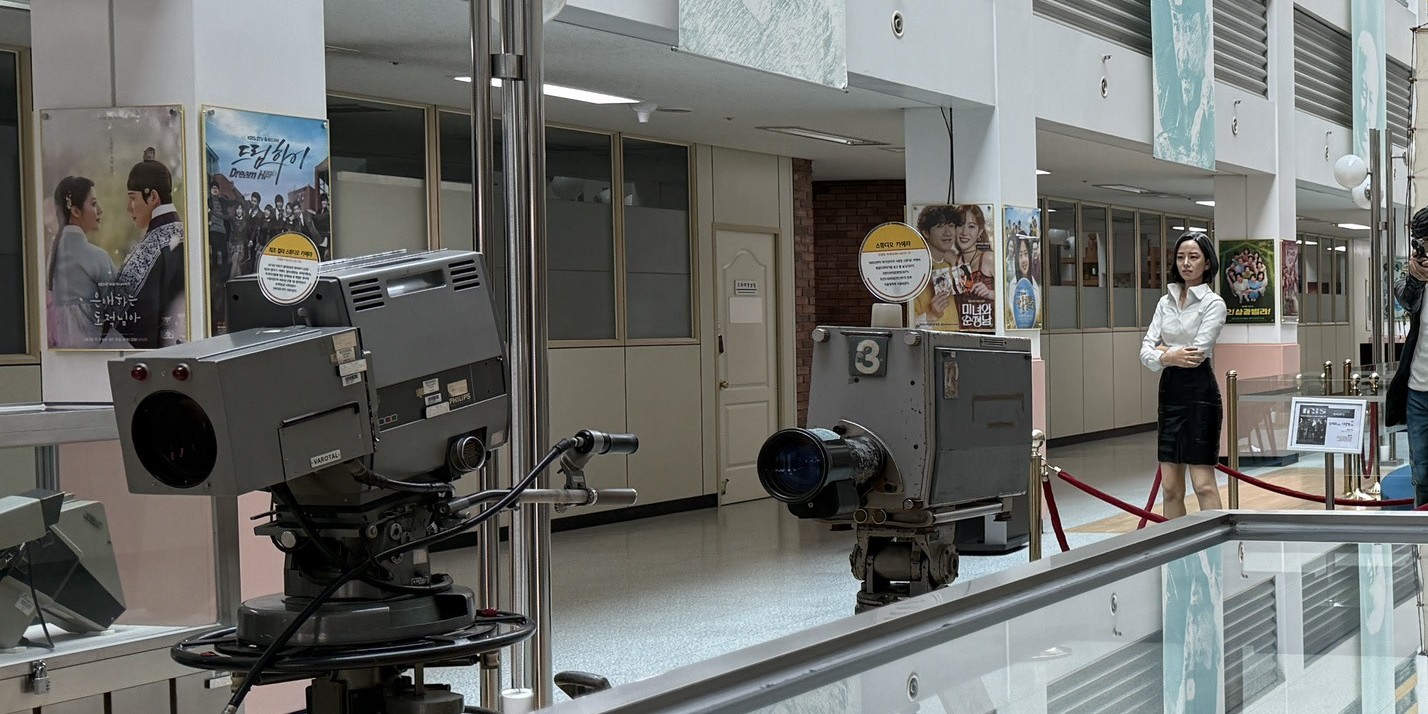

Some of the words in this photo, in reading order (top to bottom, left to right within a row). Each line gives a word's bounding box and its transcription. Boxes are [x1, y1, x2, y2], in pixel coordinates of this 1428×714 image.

[229, 167, 257, 180] Dream
[90, 291, 138, 307] 은애하는
[961, 303, 992, 315] 미녀와
[94, 311, 141, 327] 도적님아
[961, 314, 992, 328] 순정남
[855, 339, 880, 374] 3
[449, 393, 471, 404] PHILIPS
[313, 452, 339, 465] VAROTAL
